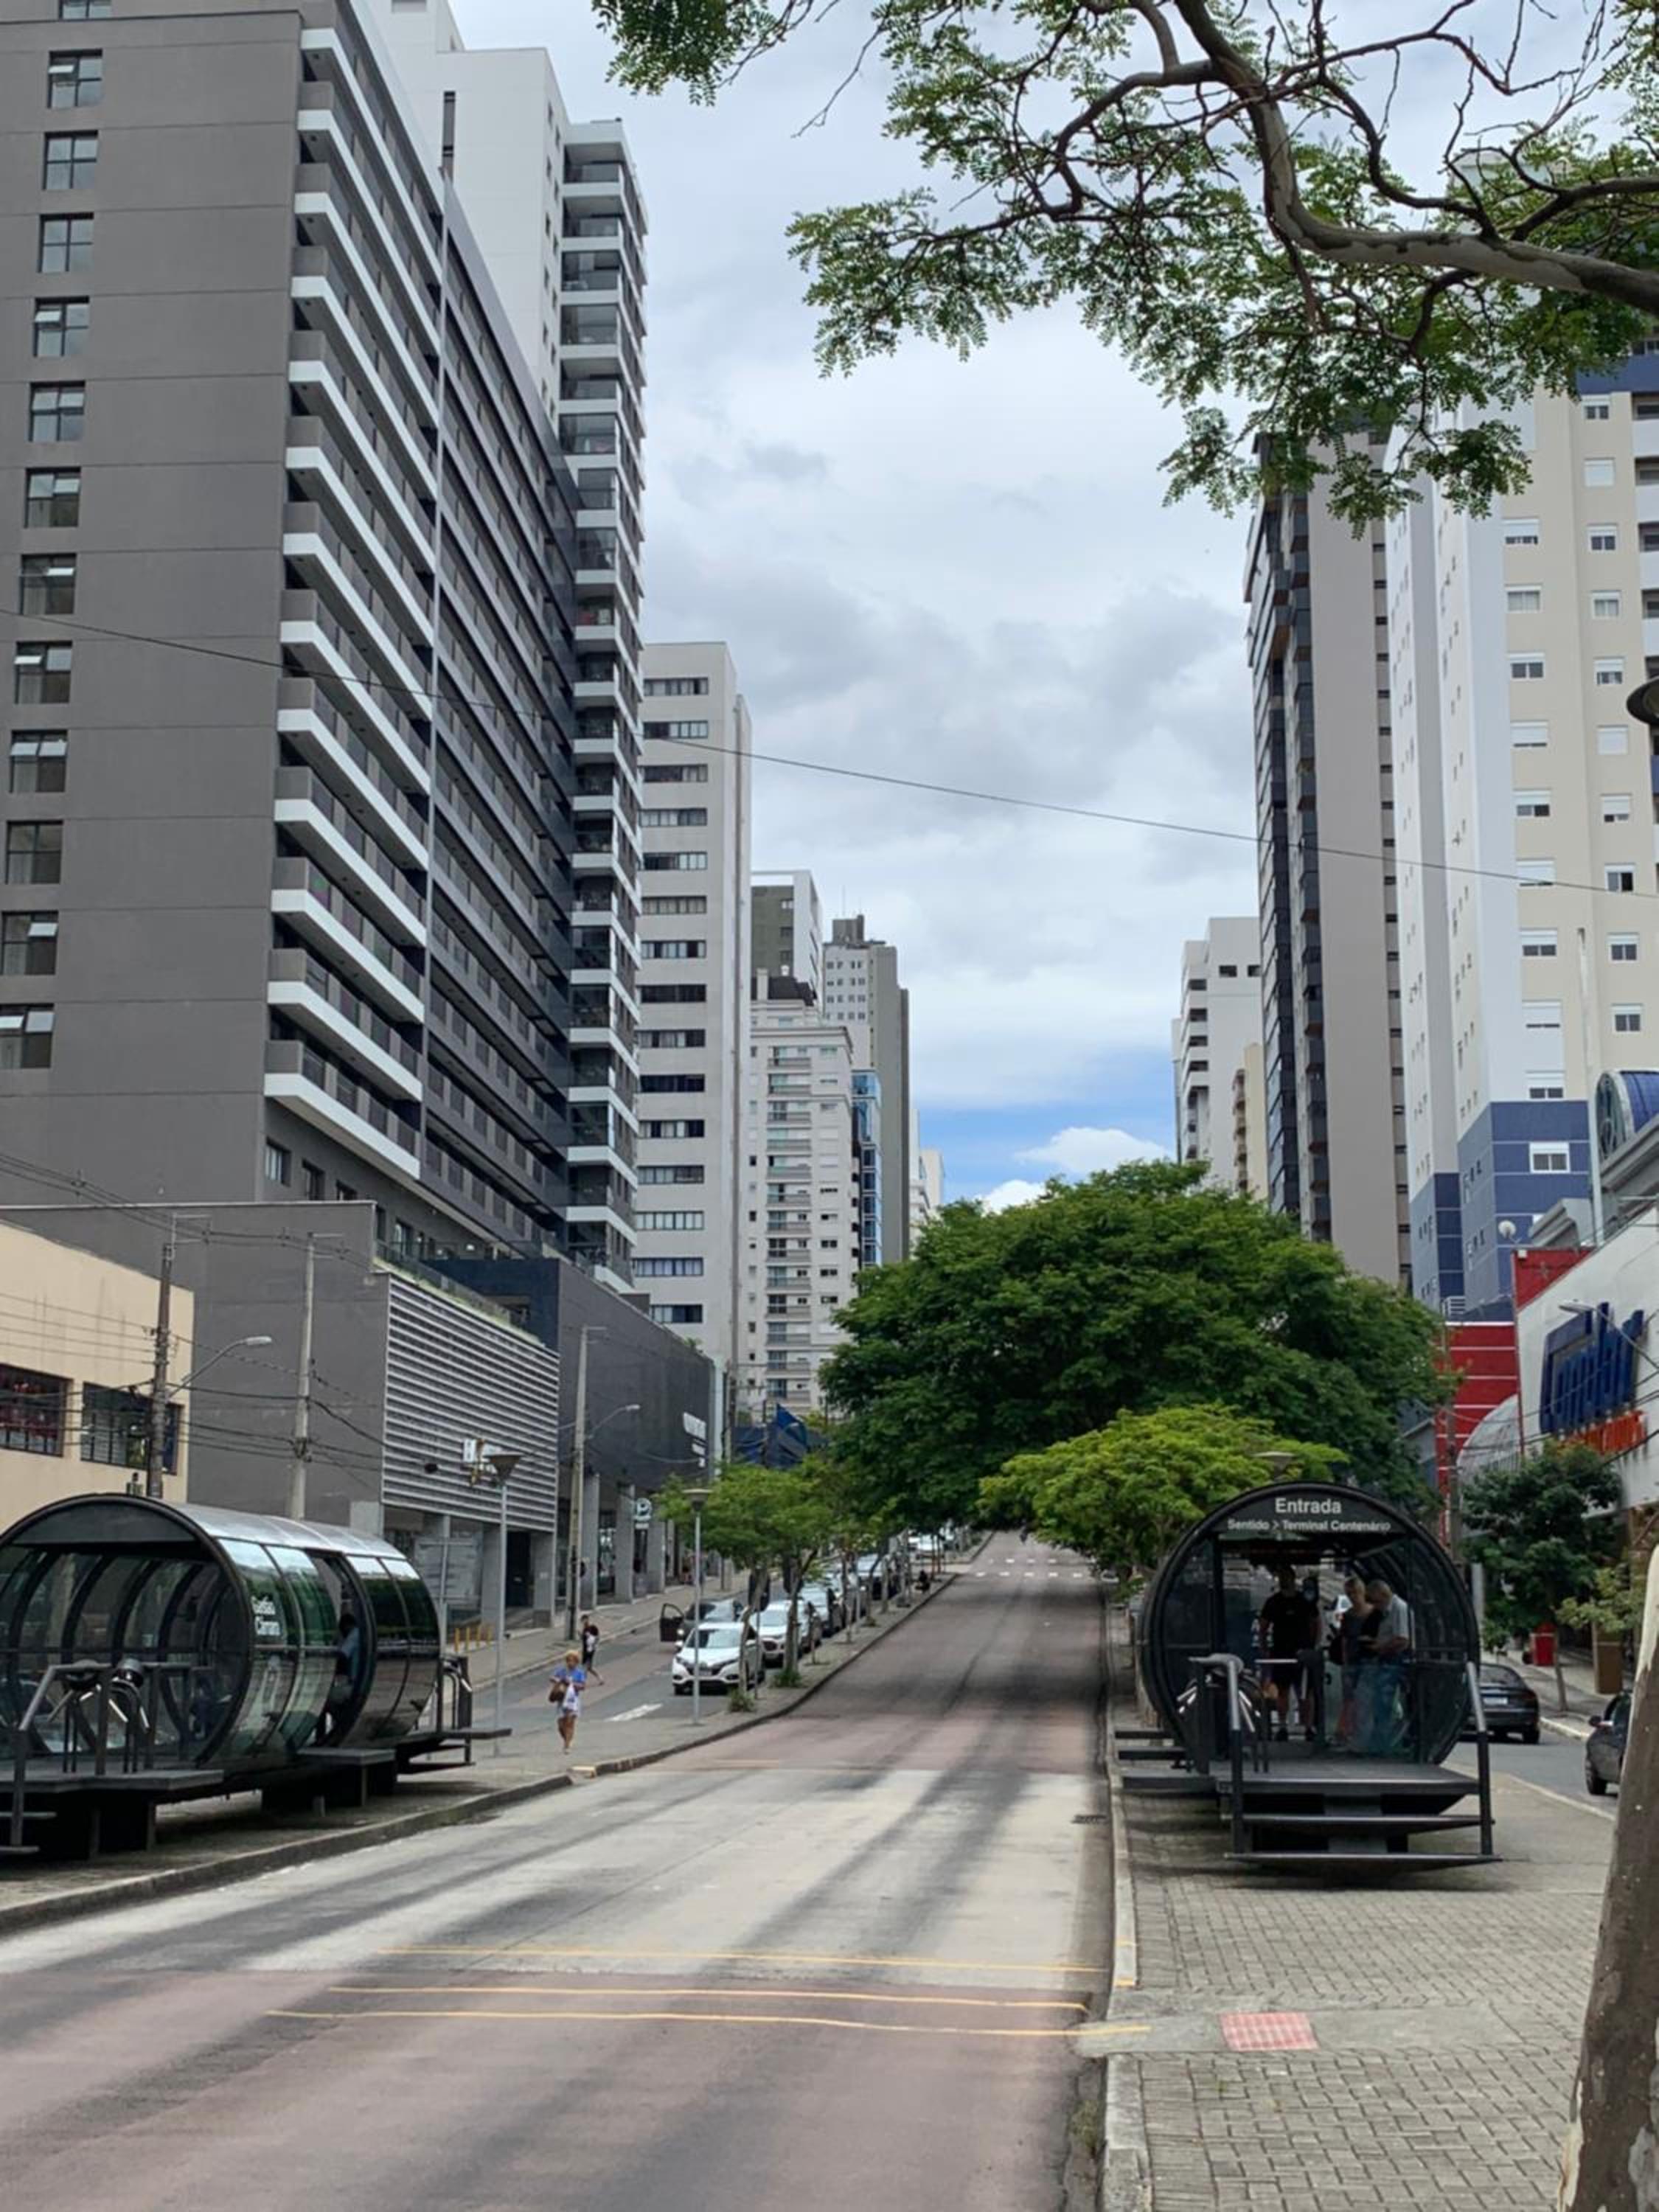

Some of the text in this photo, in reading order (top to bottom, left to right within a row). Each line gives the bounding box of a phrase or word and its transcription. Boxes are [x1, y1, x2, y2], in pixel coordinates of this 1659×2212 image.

[1275, 1498, 1341, 1514] Entrada
[1227, 1519, 1269, 1530] Sentido
[1282, 1520, 1327, 1531] Terminal
[1331, 1520, 1391, 1531] Centenário
